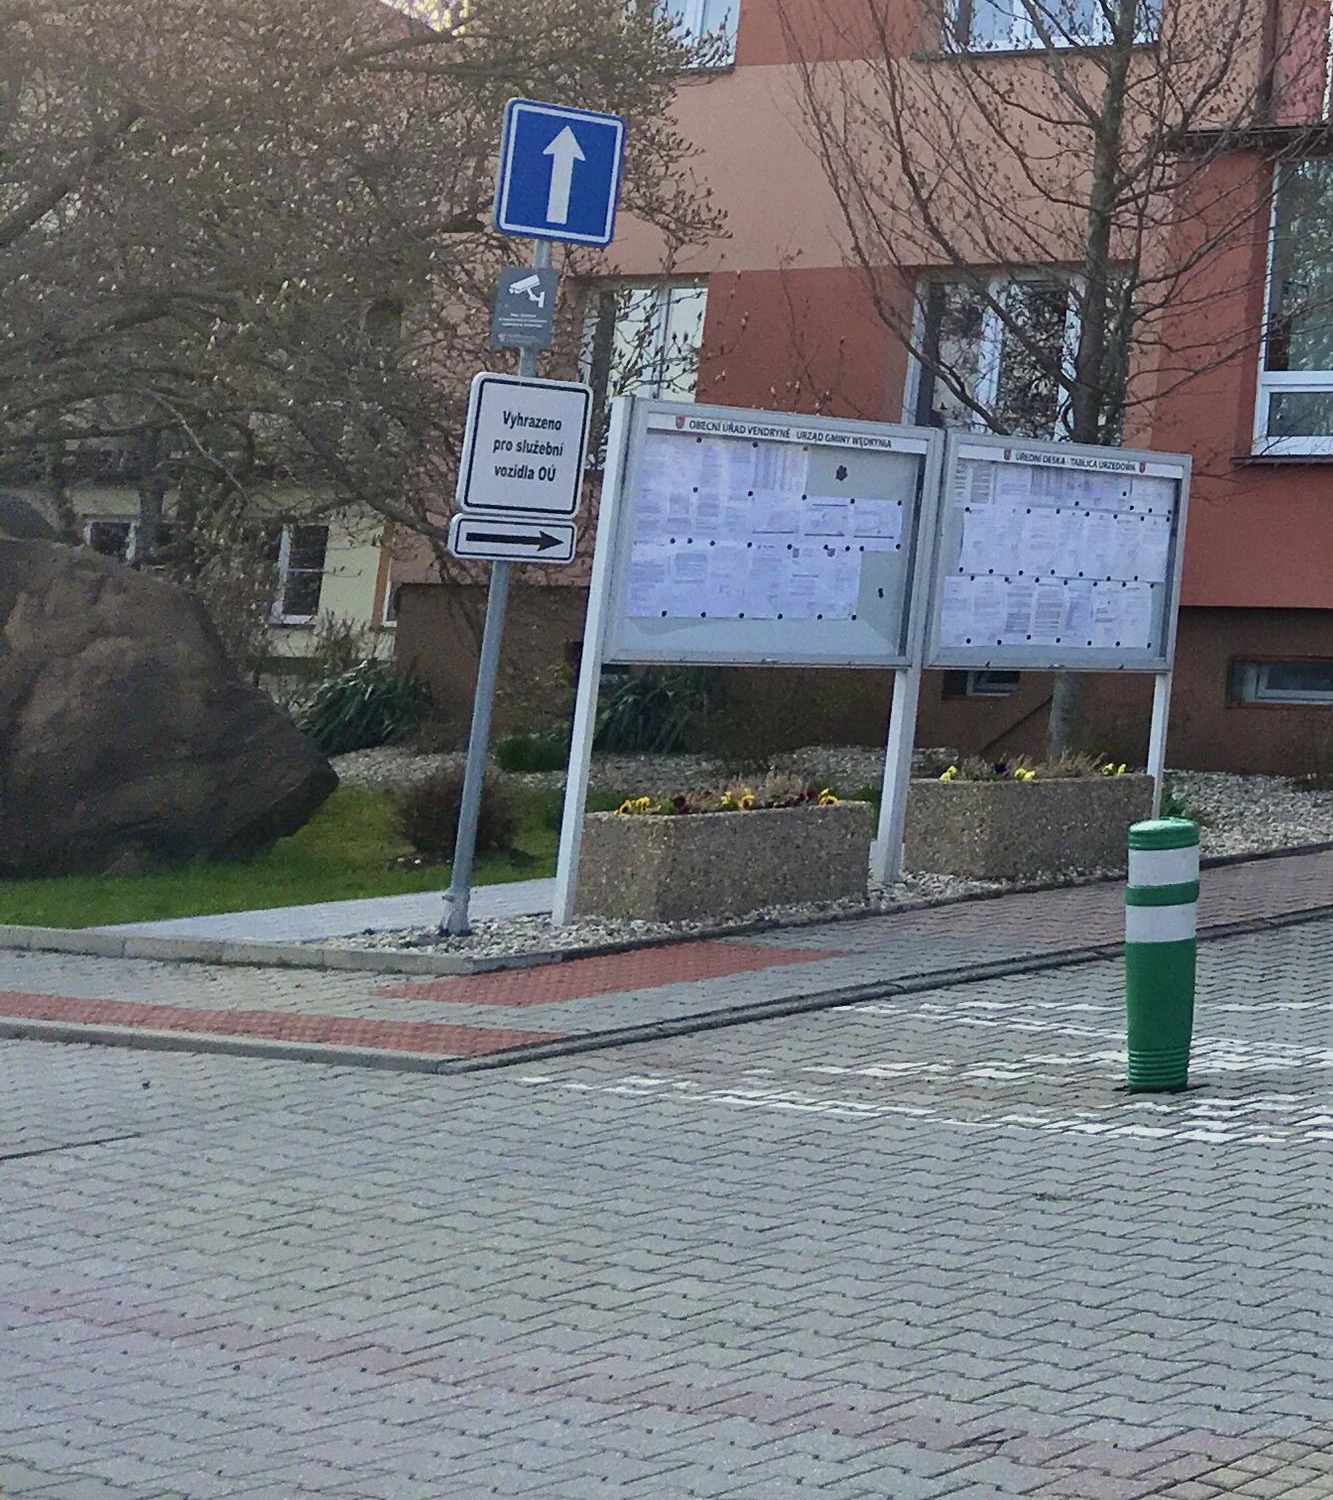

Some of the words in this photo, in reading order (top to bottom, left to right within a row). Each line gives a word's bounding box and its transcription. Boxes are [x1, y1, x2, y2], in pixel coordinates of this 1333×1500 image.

[503, 411, 562, 430] Vyhrazeno
[492, 439, 513, 453] pro
[516, 439, 564, 456] služební
[494, 464, 535, 480] vozidla
[538, 464, 556, 481] OÚ
